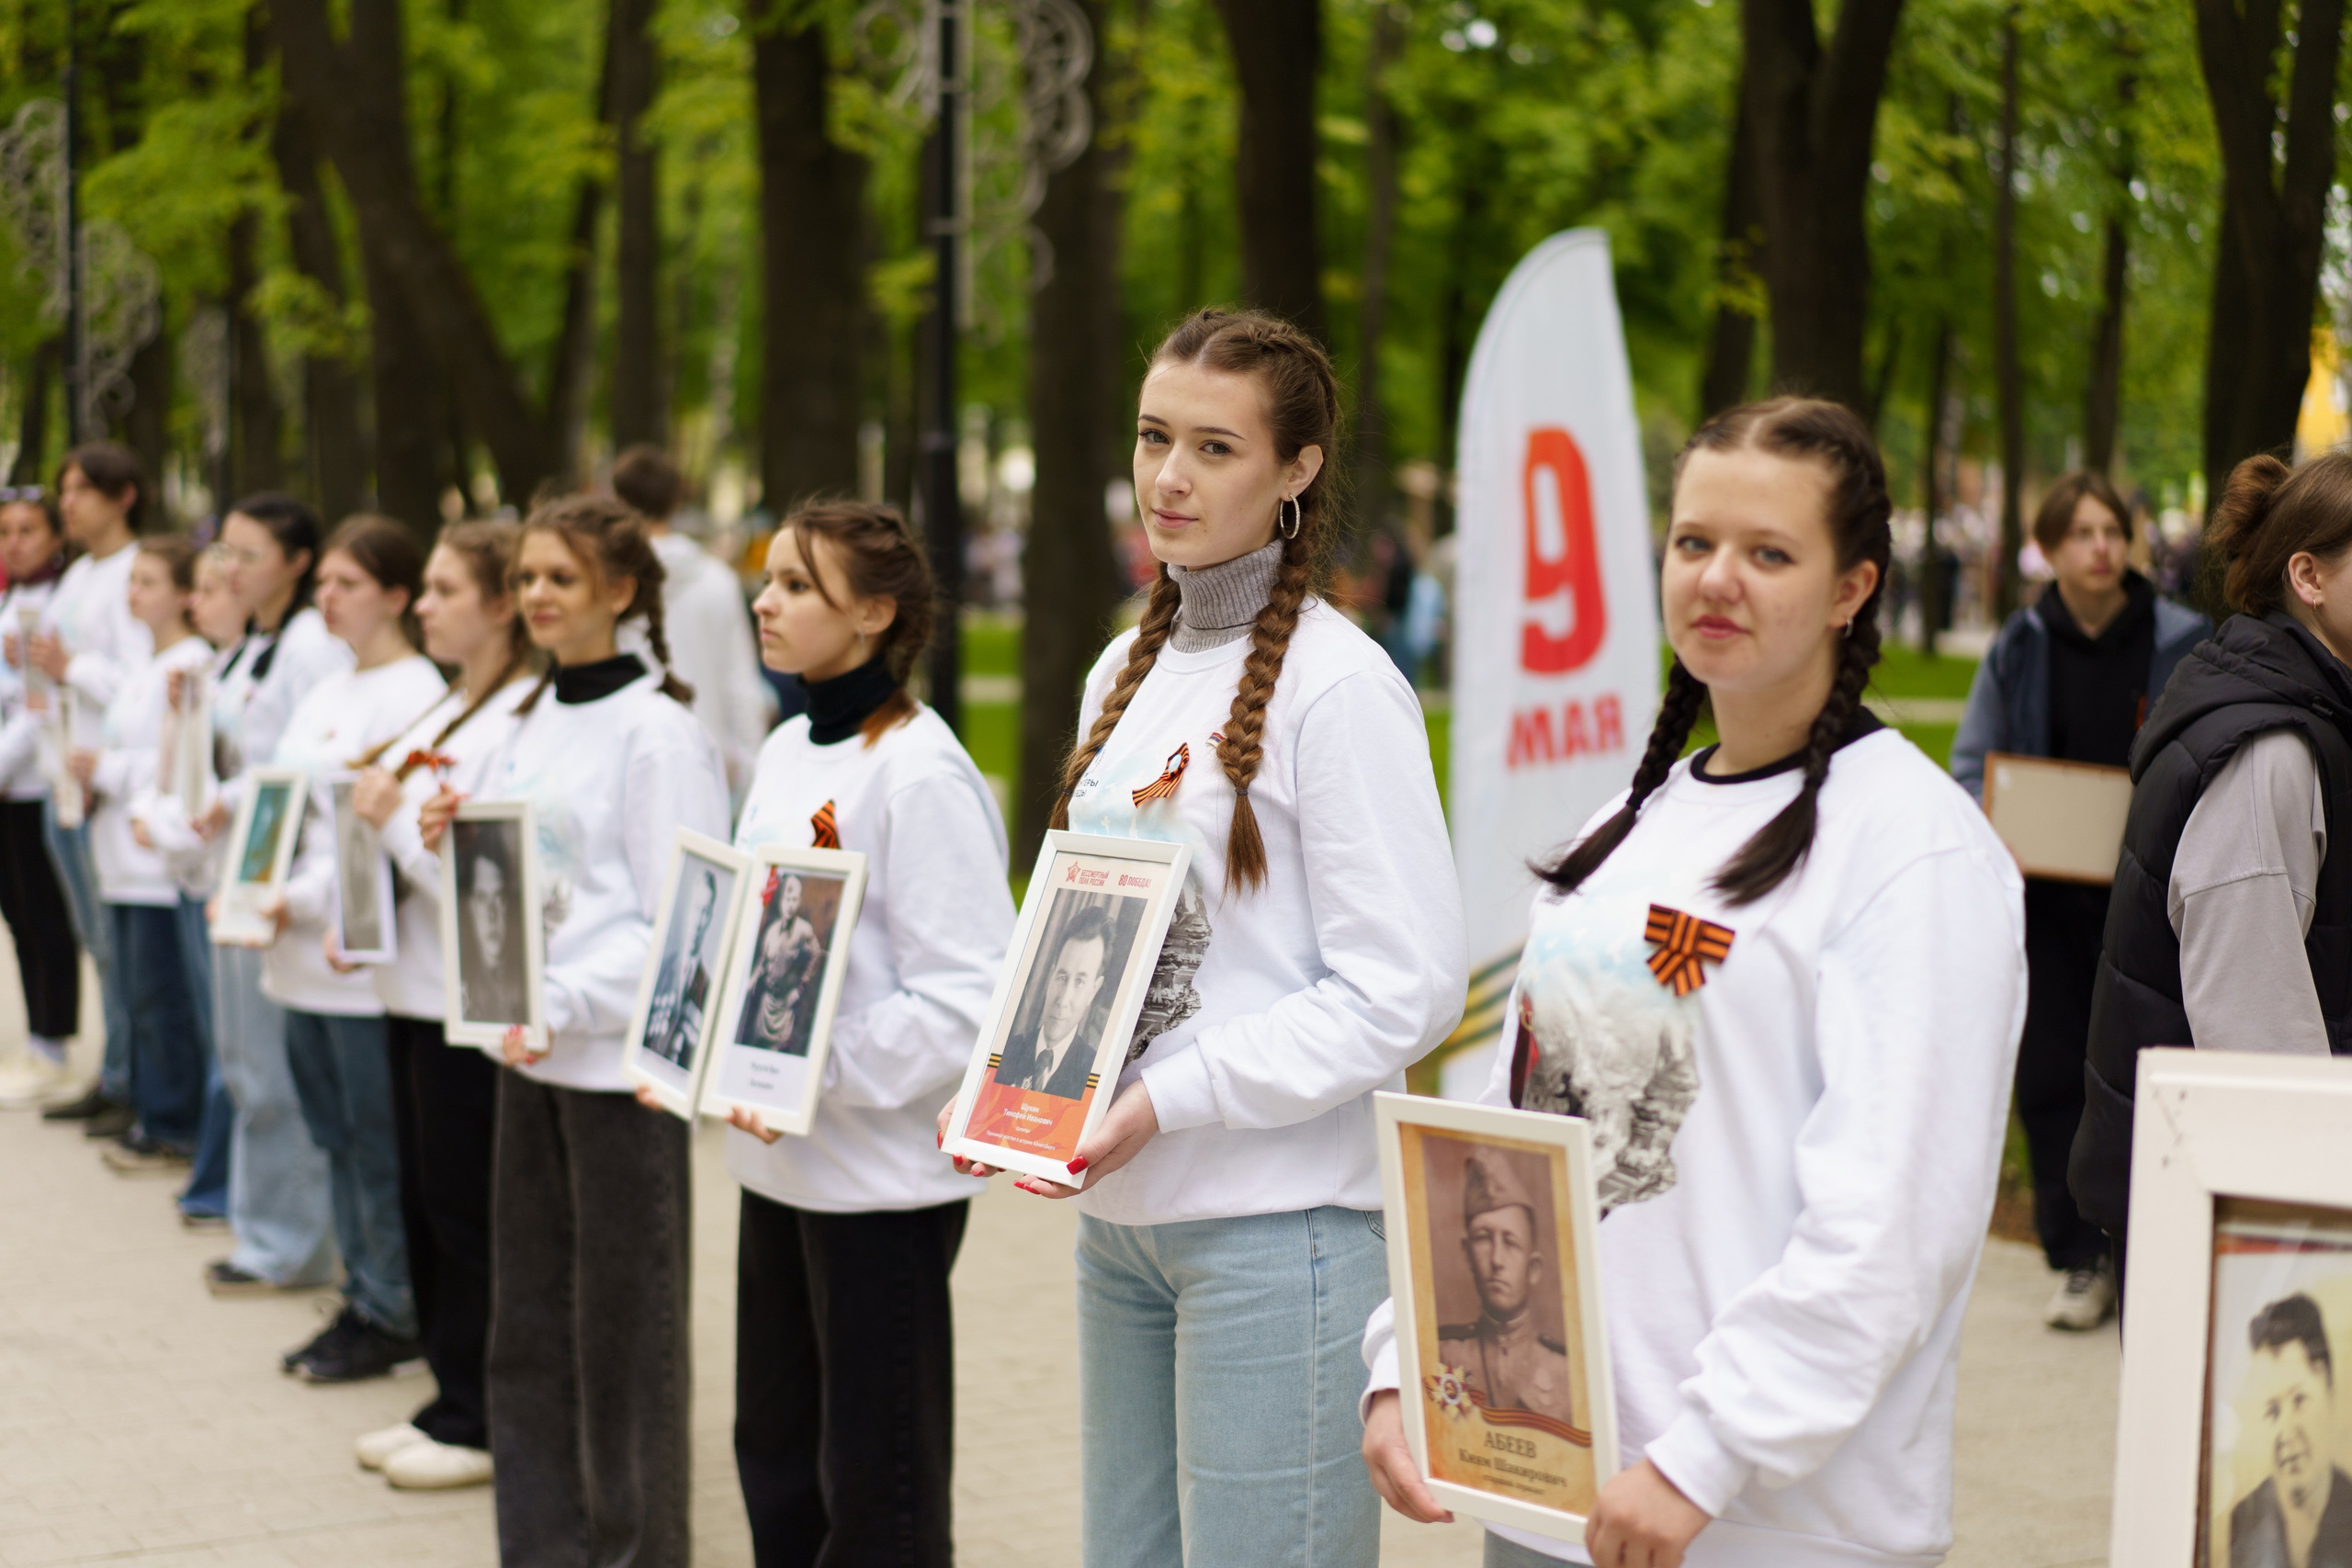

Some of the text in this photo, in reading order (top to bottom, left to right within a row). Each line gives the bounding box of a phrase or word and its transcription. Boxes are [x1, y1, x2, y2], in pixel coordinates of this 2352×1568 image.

[1521, 426, 1609, 677] 9
[1507, 693, 1625, 772] МАЯ
[1079, 876, 1105, 886] ПОЛК РОССИИ
[1080, 869, 1110, 880] БЕССМЕРТНЫЙ
[1118, 874, 1152, 888] 80 ПОБЕДА!
[1021, 1102, 1040, 1113] Щукин
[1003, 1108, 1053, 1126] Тимофей Иванович
[1484, 1430, 1537, 1458] АБЕЕВ
